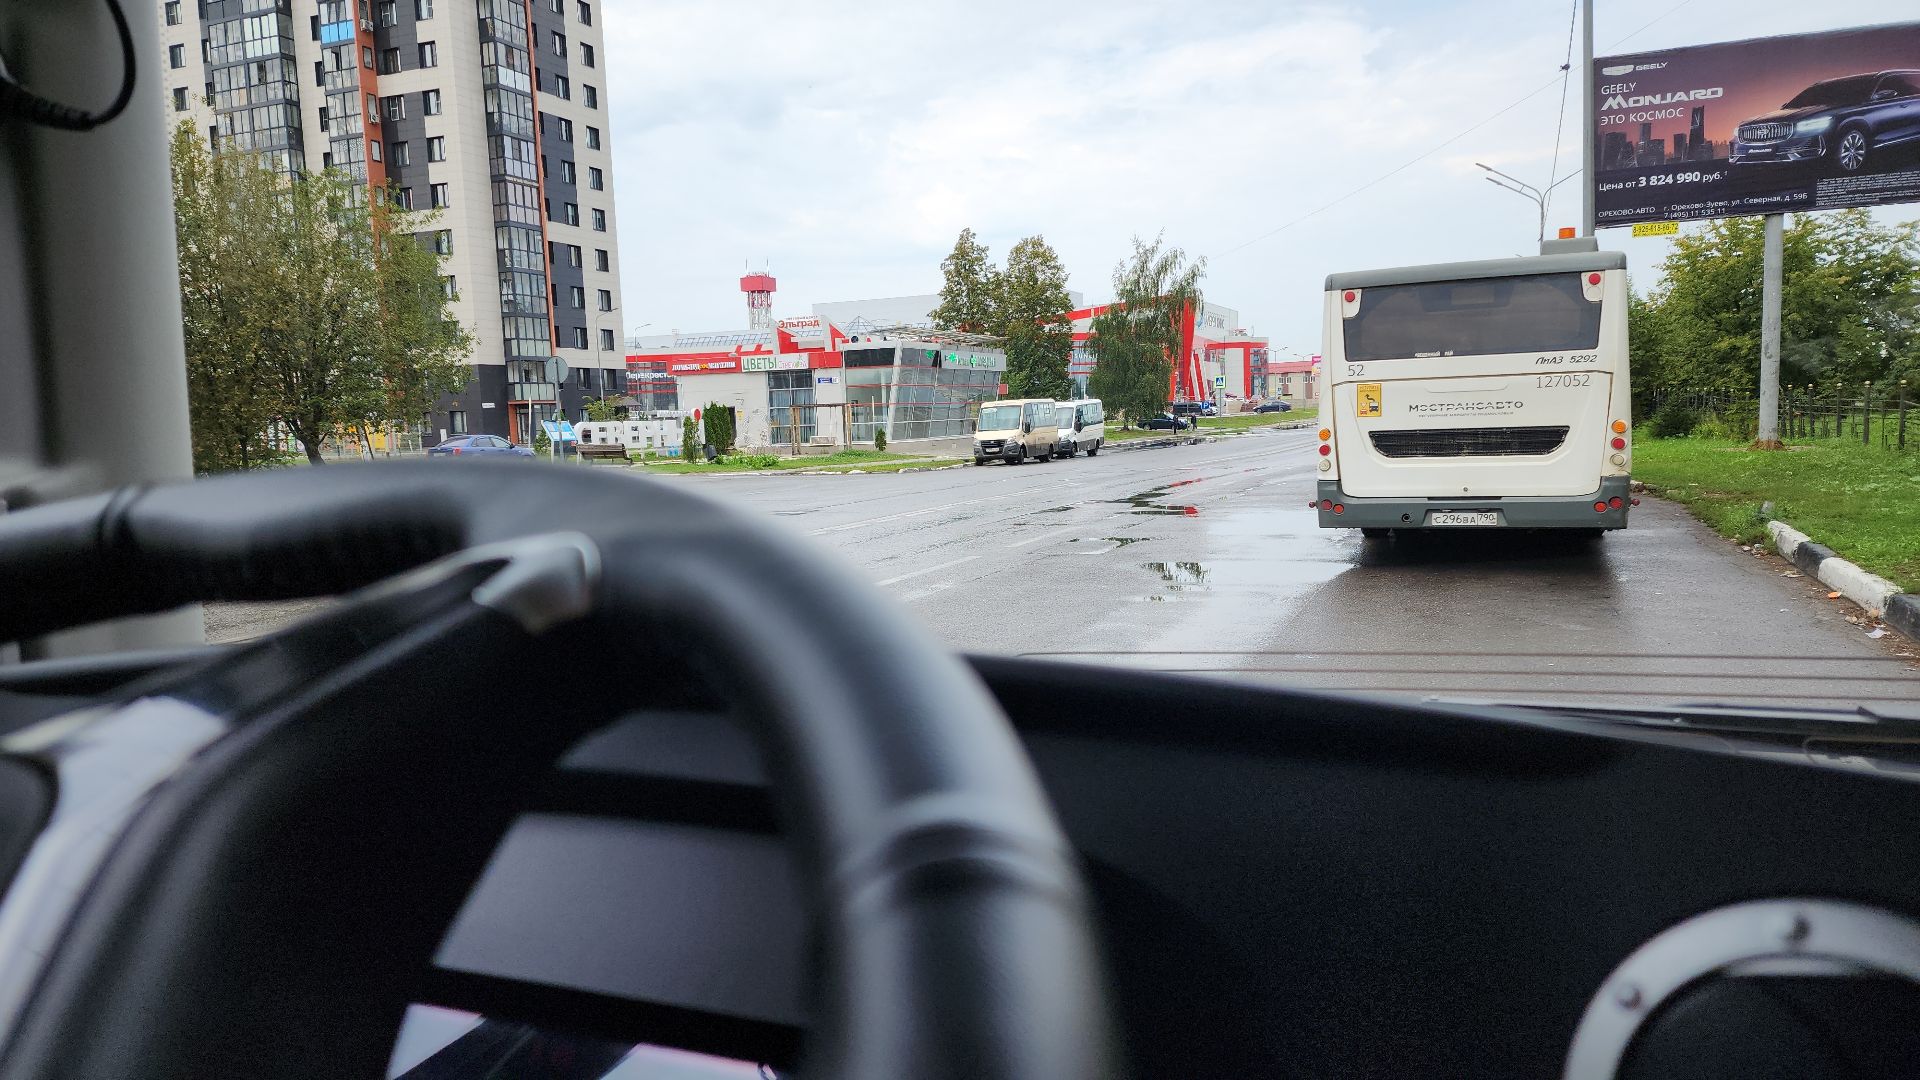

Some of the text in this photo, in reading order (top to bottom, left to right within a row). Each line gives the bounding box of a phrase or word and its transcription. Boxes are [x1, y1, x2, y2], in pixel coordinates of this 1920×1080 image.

[1636, 62, 1668, 71] GEELY
[1601, 82, 1637, 95] GEELY
[1601, 87, 1723, 111] MONJARO
[1600, 107, 1685, 126] ЭТО КОСМОС
[1599, 181, 1623, 192] Цена
[1625, 181, 1636, 189] от
[1638, 176, 1647, 187] 3
[1649, 174, 1673, 186] 824
[1676, 171, 1701, 184] 990
[778, 320, 819, 329] Эльград
[742, 357, 777, 371] ЦВЕТЫ
[1569, 354, 1598, 363] 5292
[1348, 364, 1365, 376] 52
[1536, 374, 1591, 389] 127052
[1409, 401, 1524, 413] МОСТРАНСАВТО
